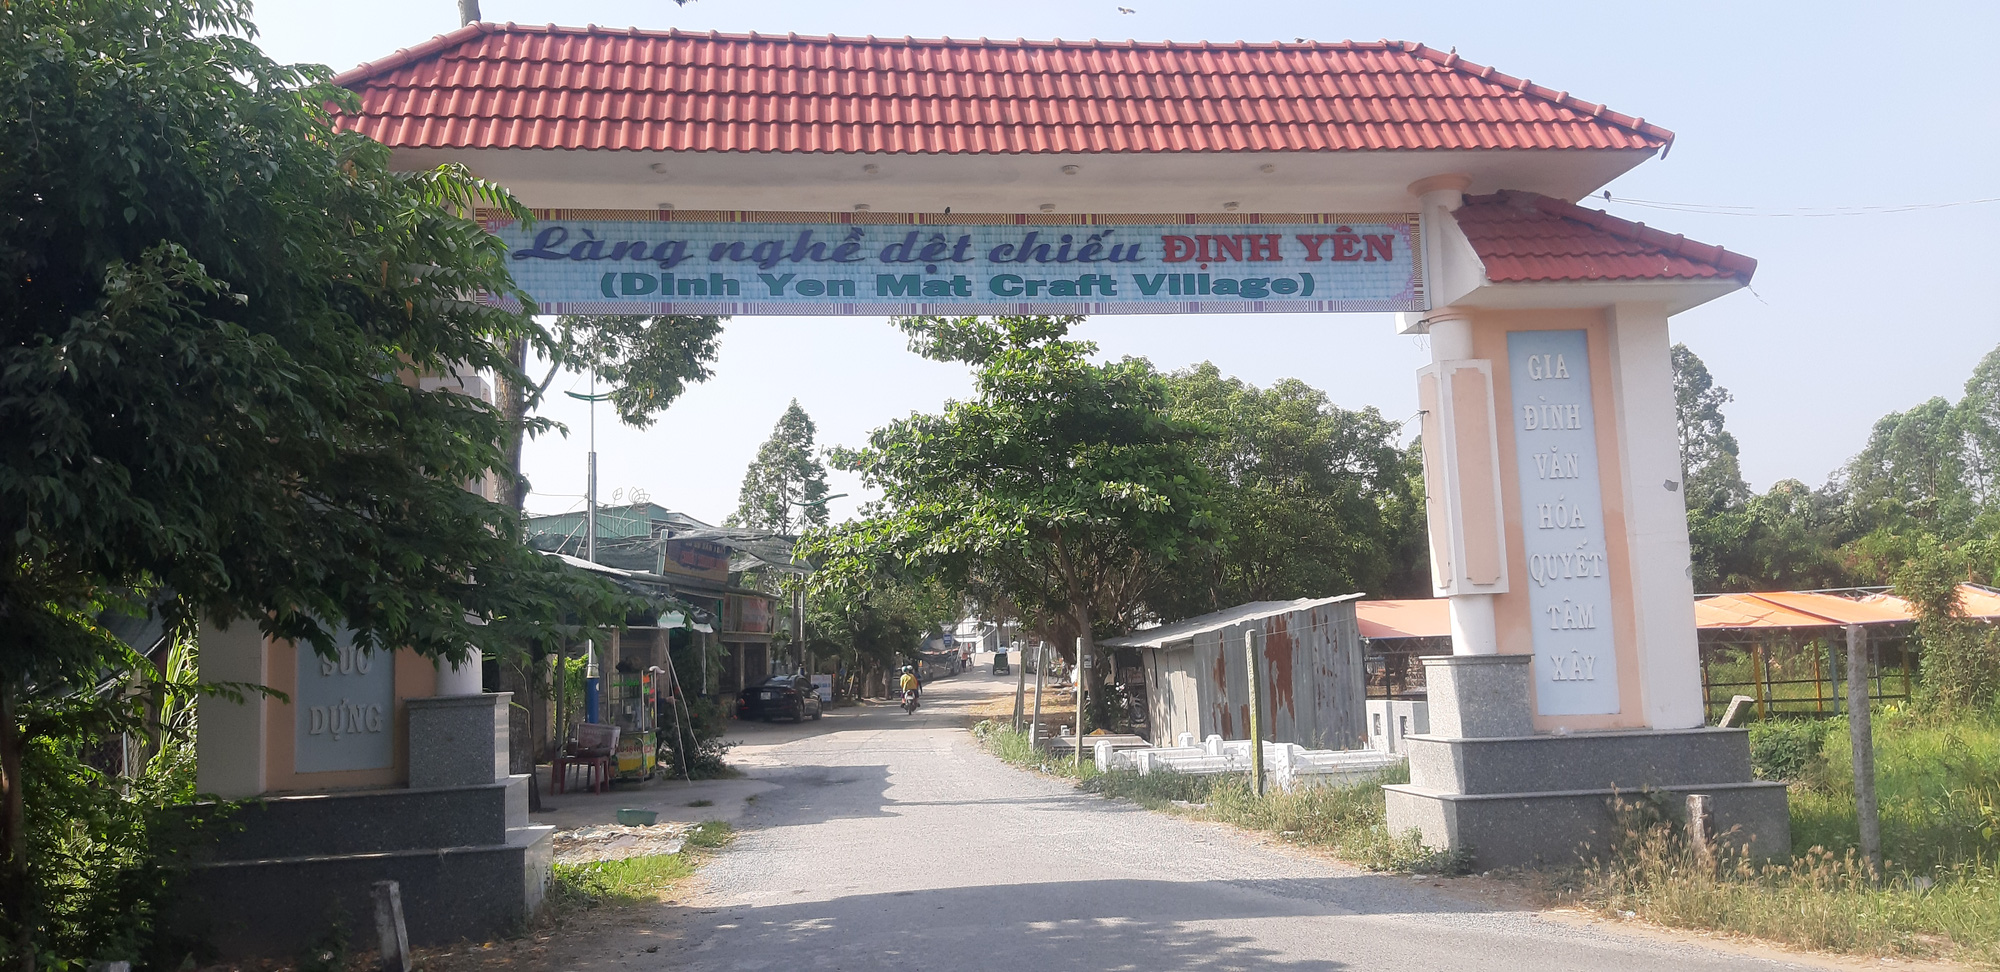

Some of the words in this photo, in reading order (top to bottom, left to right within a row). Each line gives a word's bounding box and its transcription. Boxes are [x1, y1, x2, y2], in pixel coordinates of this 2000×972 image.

[512, 226, 694, 270] Làng
[708, 226, 866, 270] nghề
[879, 230, 976, 274] dệt
[988, 229, 1146, 264] chiếu
[1161, 233, 1284, 271] ĐỊNH
[1298, 226, 1396, 262] YÊN
[600, 272, 741, 298] (Dinh
[757, 273, 857, 298] Yen
[876, 274, 972, 297] Mat
[989, 274, 1118, 297] Craft
[1132, 272, 1315, 298] Village)
[1527, 353, 1571, 381] GIA
[1522, 395, 1583, 431] ĐÌNH
[1532, 445, 1580, 480] VĂN
[1536, 493, 1587, 530] HÓA
[1529, 537, 1604, 588] QUYẾT
[1545, 596, 1597, 631] TÂM
[1550, 646, 1598, 682] XÂY
